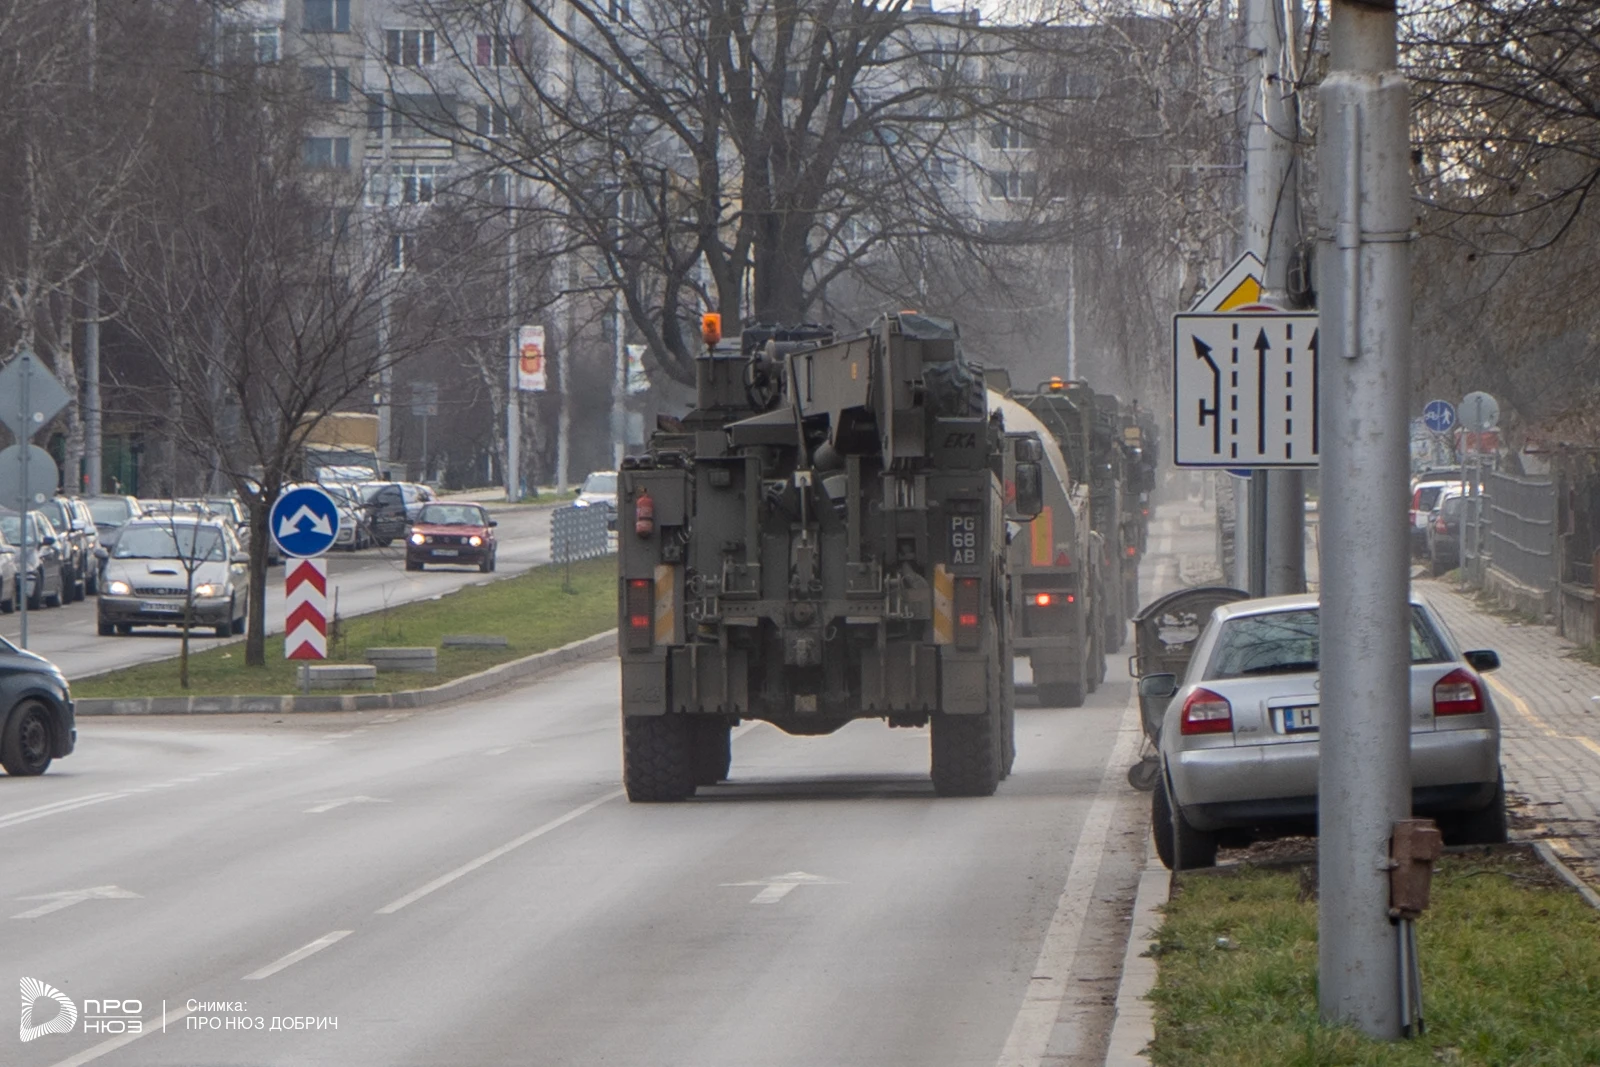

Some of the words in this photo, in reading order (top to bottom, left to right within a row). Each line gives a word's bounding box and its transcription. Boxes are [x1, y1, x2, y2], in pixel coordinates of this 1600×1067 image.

[943, 432, 976, 449] EKA
[952, 516, 975, 531] PG
[952, 532, 975, 548] 68
[953, 549, 975, 564] AB
